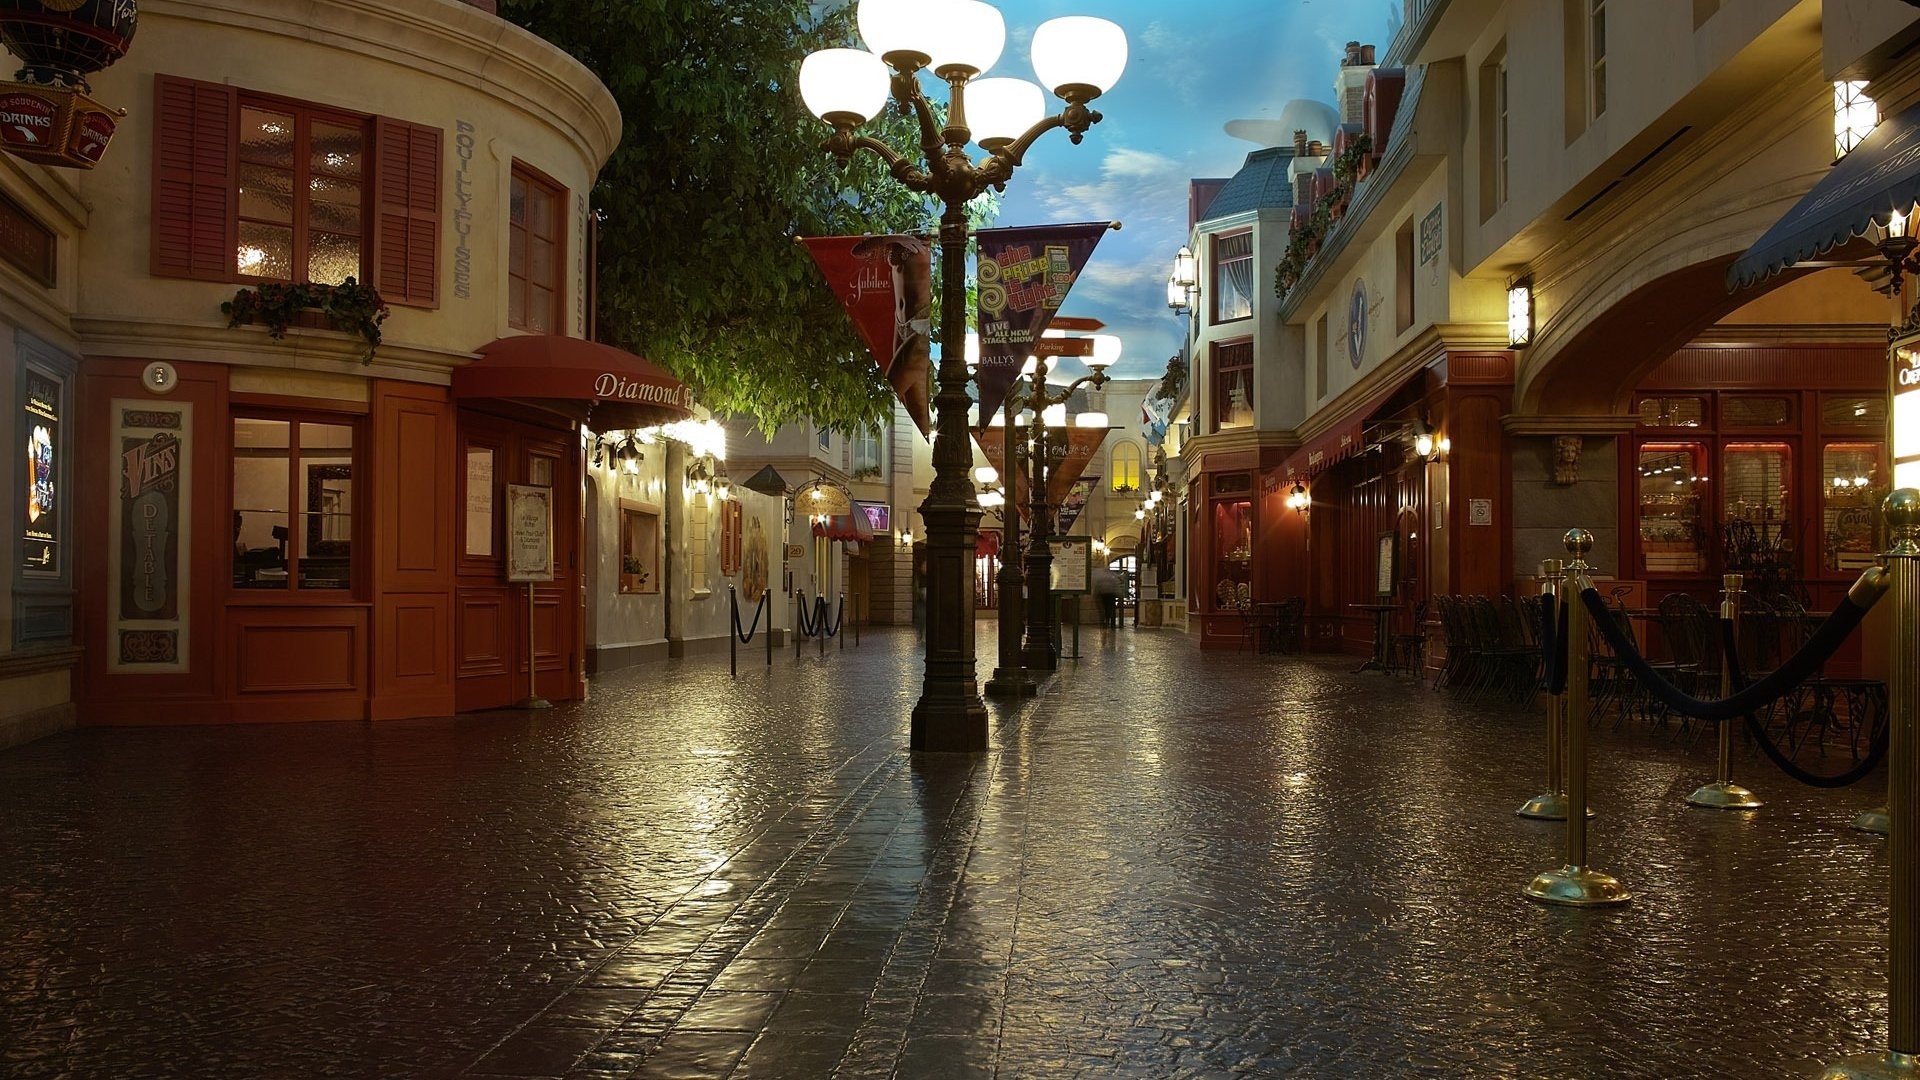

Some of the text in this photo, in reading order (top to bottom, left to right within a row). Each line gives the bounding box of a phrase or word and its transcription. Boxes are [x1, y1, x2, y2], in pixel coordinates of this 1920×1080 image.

[0, 111, 51, 128] DRINKS
[81, 126, 110, 147] DRINKS
[985, 321, 1010, 336] LIVE
[994, 329, 1031, 338] ALL NEW
[982, 335, 1035, 344] STAGE SHOW
[1040, 344, 1065, 353] Parking
[982, 355, 1015, 365] BALLY'S
[595, 373, 684, 406] Diamond
